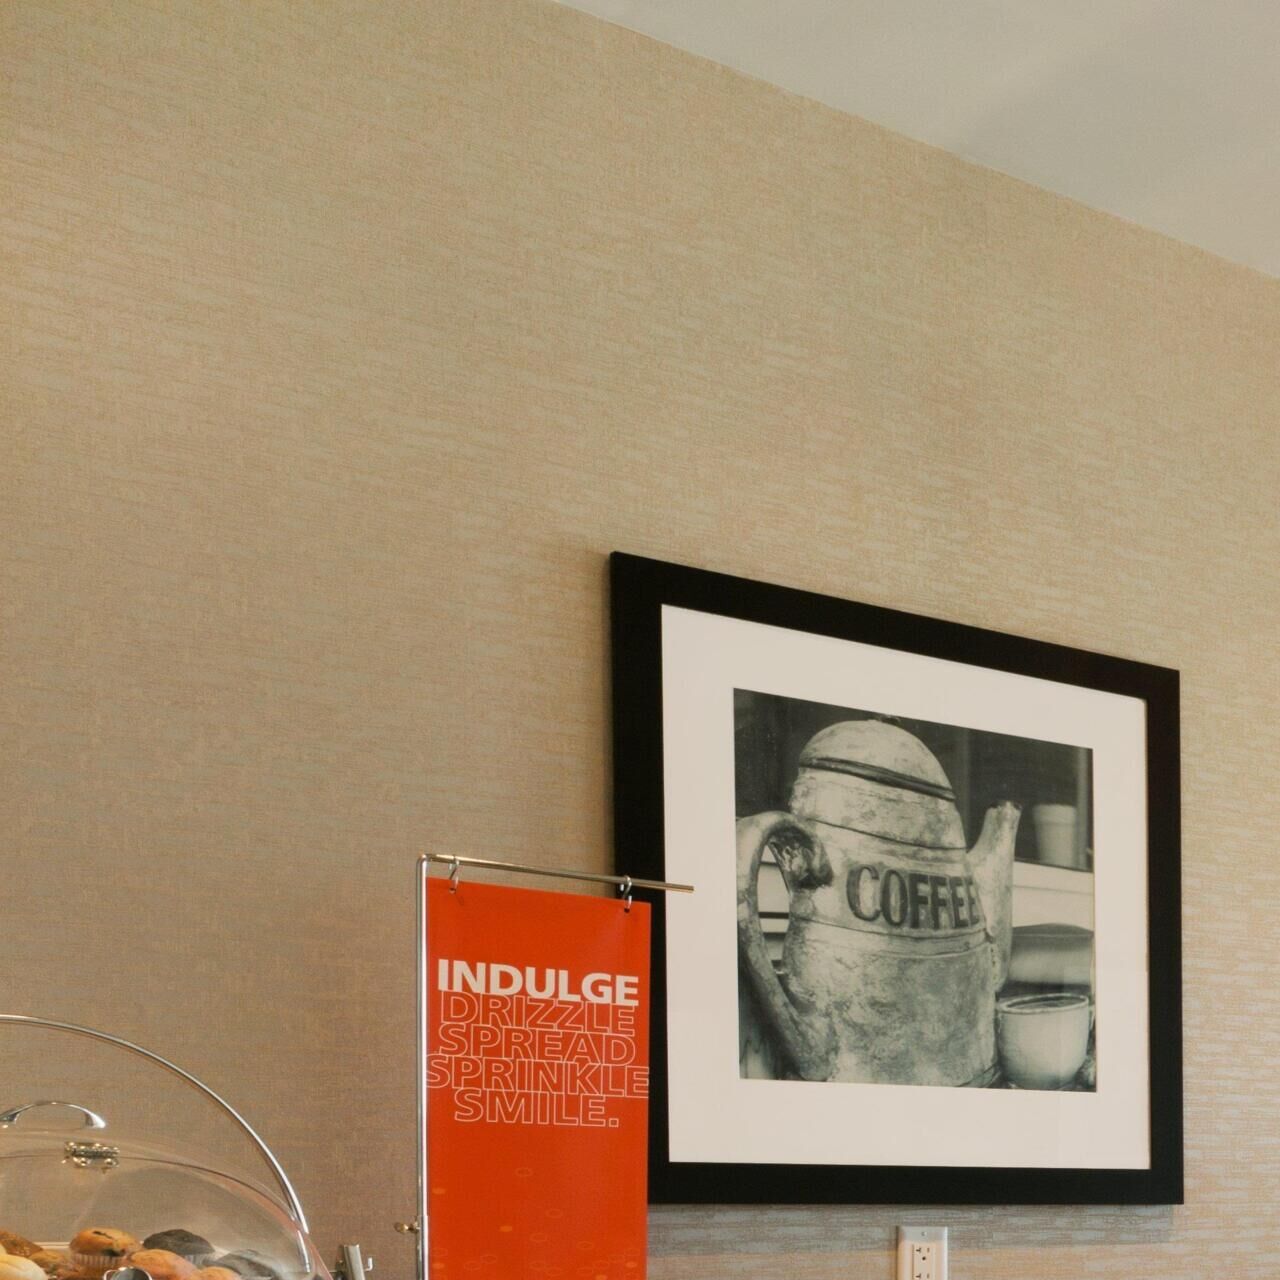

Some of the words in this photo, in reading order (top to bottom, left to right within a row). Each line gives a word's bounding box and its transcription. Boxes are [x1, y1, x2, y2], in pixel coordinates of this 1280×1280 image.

[846, 864, 980, 930] COFFEE
[438, 958, 639, 1007] INDULGE
[441, 990, 636, 1037] DRIZZLE
[439, 1022, 636, 1067] SPREAD
[426, 1054, 650, 1099] SPRINKLE
[454, 1087, 619, 1128] SMILE.
